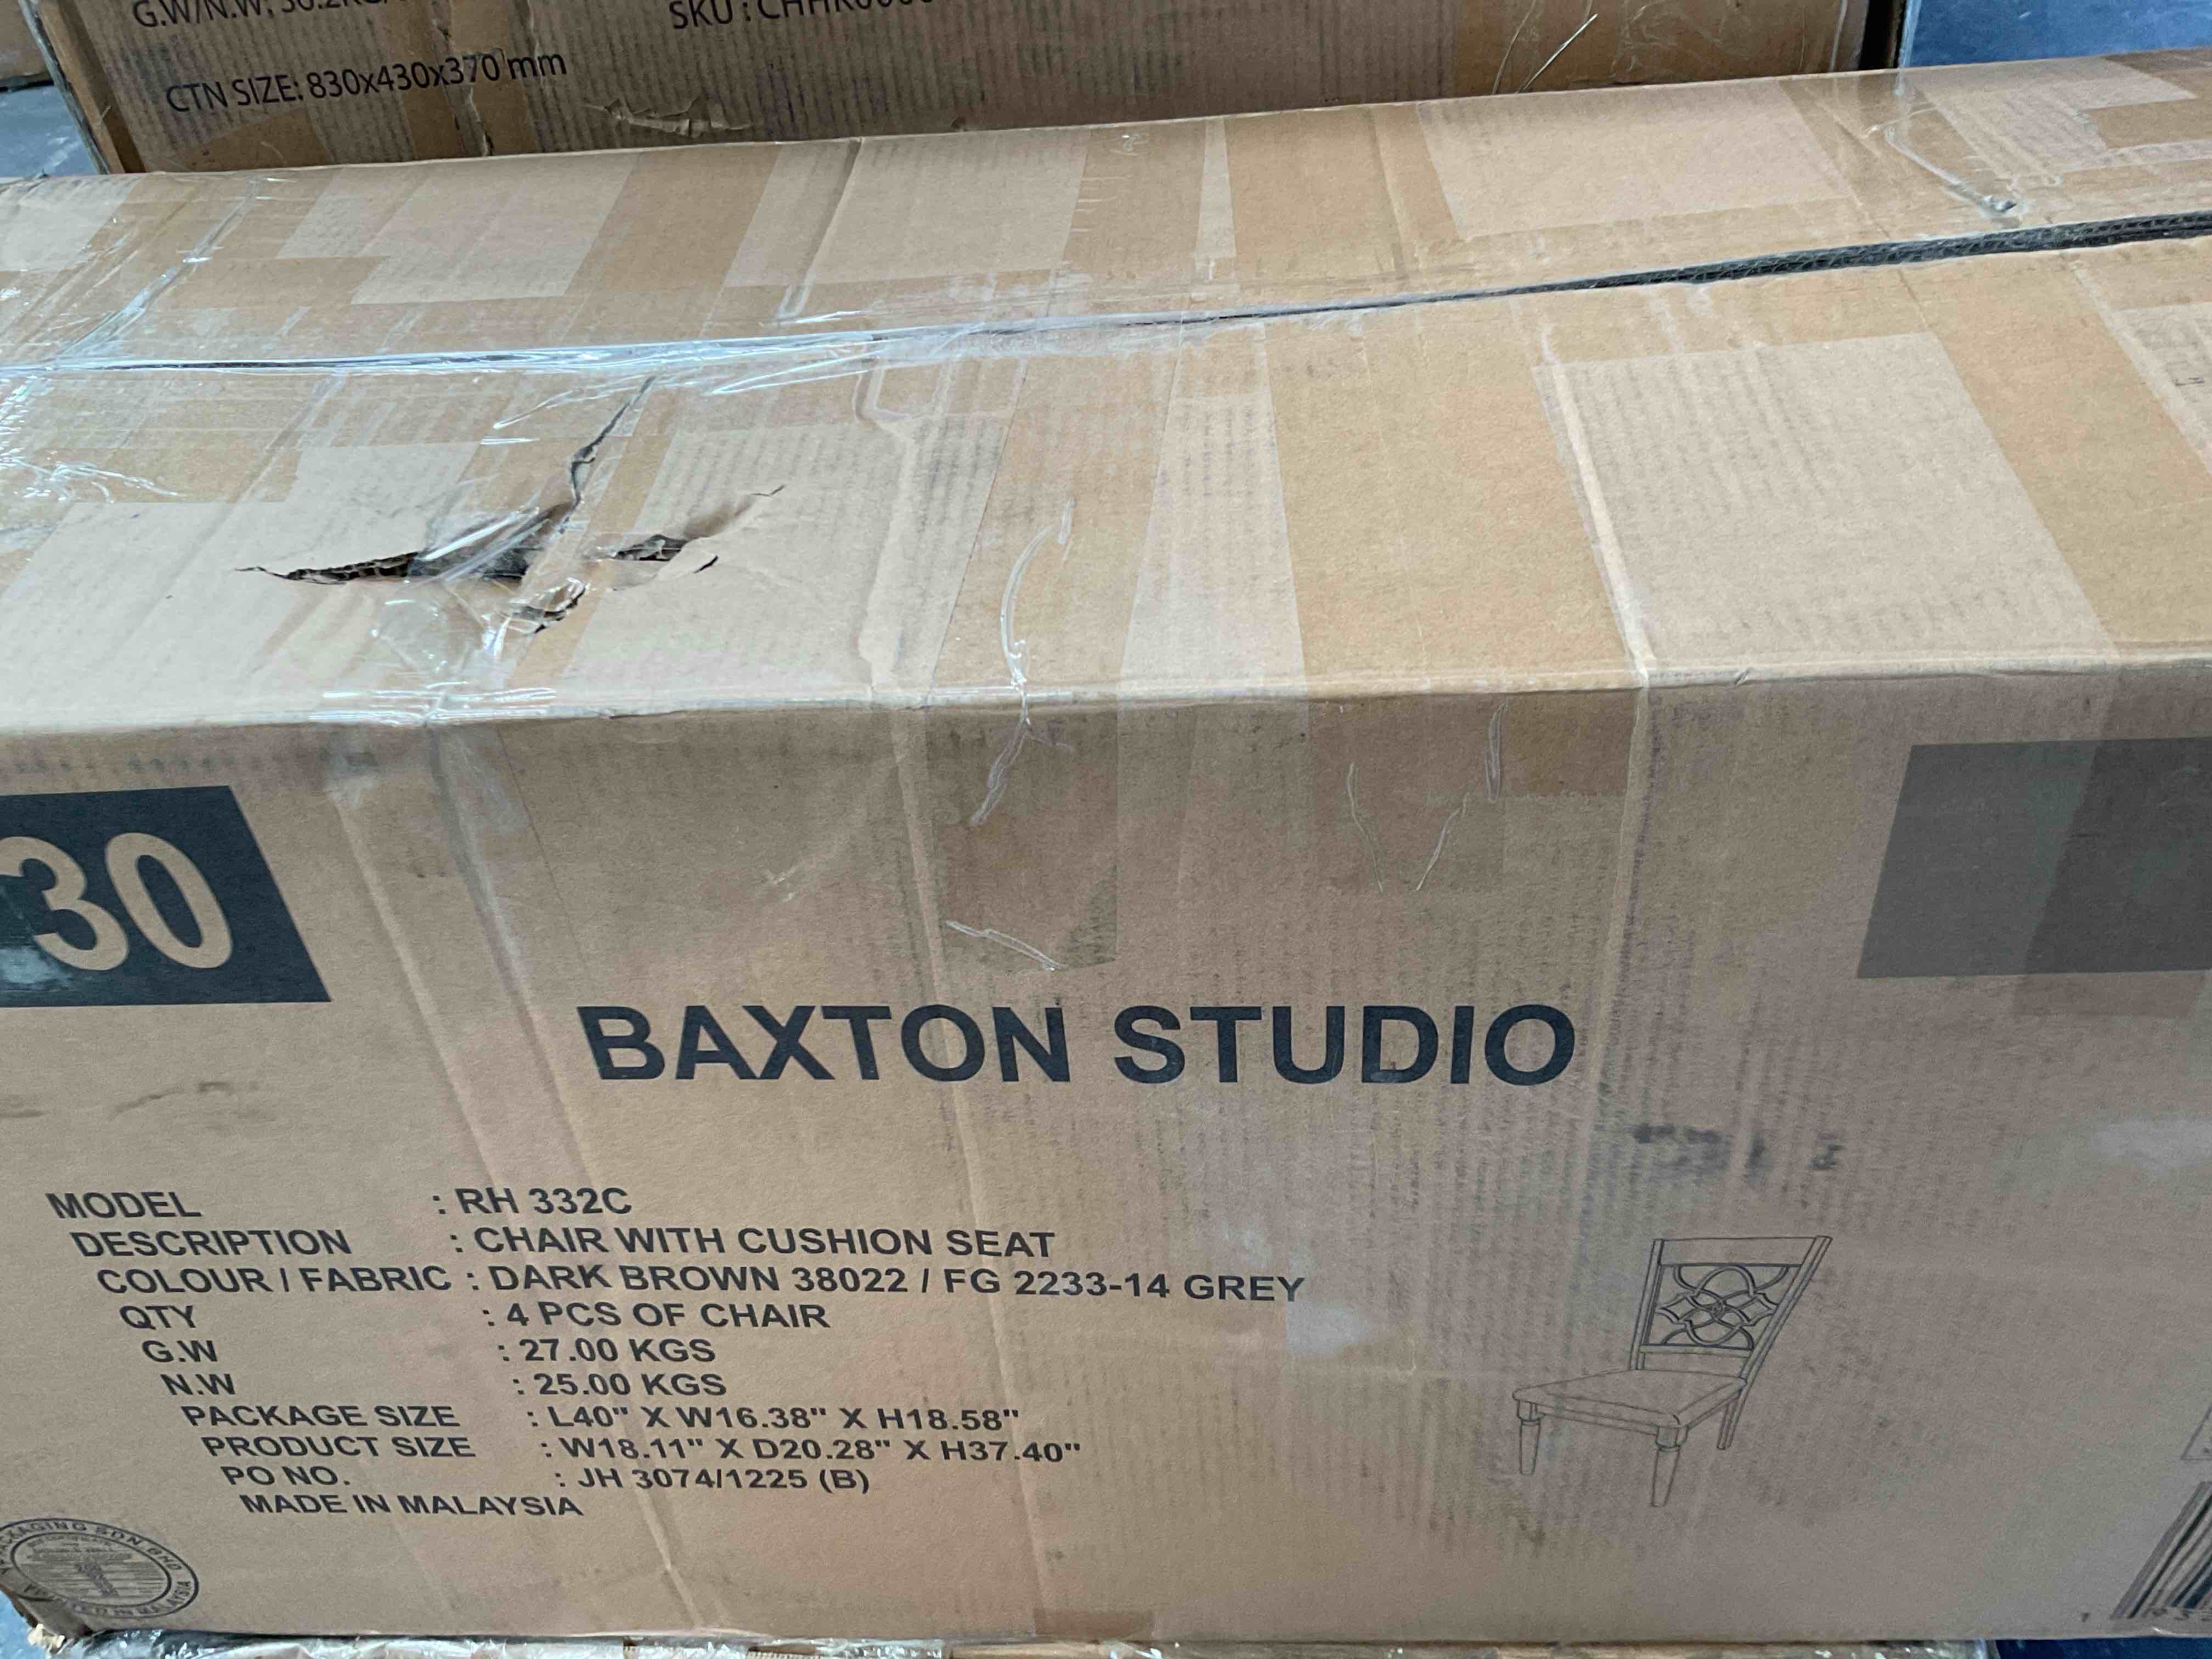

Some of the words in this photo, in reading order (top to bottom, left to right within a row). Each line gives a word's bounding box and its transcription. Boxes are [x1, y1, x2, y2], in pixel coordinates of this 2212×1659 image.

[166, 83, 228, 112] CTN
[232, 74, 303, 106] SIZE:
[307, 54, 501, 100] 830x430x370
[508, 53, 568, 81] mm
[575, 1005, 1071, 1083] BAXTON
[1113, 1003, 1576, 1086] STUDIO
[44, 1191, 203, 1219] MODEL
[454, 1187, 520, 1214] RH
[528, 1187, 632, 1214] 332C
[69, 1229, 352, 1257] DESCRIPTION
[473, 1226, 610, 1253] CHAIR
[613, 1227, 726, 1254] WITH
[737, 1227, 933, 1255] CUSHION
[946, 1229, 1056, 1257] SEAT
[97, 1268, 274, 1294] COLOUR
[298, 1265, 452, 1292] FABRIC
[487, 1265, 612, 1290] DARK
[618, 1265, 780, 1291] BROWN
[791, 1267, 909, 1293] 38022
[943, 1268, 1001, 1294] FG
[1013, 1270, 1170, 1299] 2233-14
[1184, 1274, 1305, 1302] GREY
[119, 1305, 196, 1330] QTY
[506, 1303, 530, 1327] 4
[537, 1301, 622, 1327] PCS
[632, 1302, 685, 1327] OF
[700, 1303, 831, 1329] CHAIR
[142, 1340, 218, 1363] G.W
[519, 1338, 618, 1362] 27.00
[628, 1338, 716, 1363] KGS
[160, 1373, 236, 1396] N.W
[533, 1373, 631, 1396] 25.00
[640, 1373, 727, 1396] KGS
[180, 1405, 369, 1427] PACKAGE
[374, 1405, 461, 1427] SIZE
[640, 1406, 672, 1428] X
[838, 1407, 868, 1429] X
[200, 1436, 379, 1457] PRODUCT
[391, 1436, 476, 1458] SIZE
[715, 1438, 744, 1459] X
[902, 1440, 931, 1460] X
[220, 1466, 275, 1486] PO
[281, 1465, 351, 1486] NO.
[578, 1468, 624, 1488] JH
[631, 1468, 808, 1489] 3074/1225
[819, 1469, 869, 1494] (B)
[239, 1494, 348, 1514] MADE
[352, 1494, 391, 1514] IN
[397, 1495, 584, 1516] MALAYSIA
